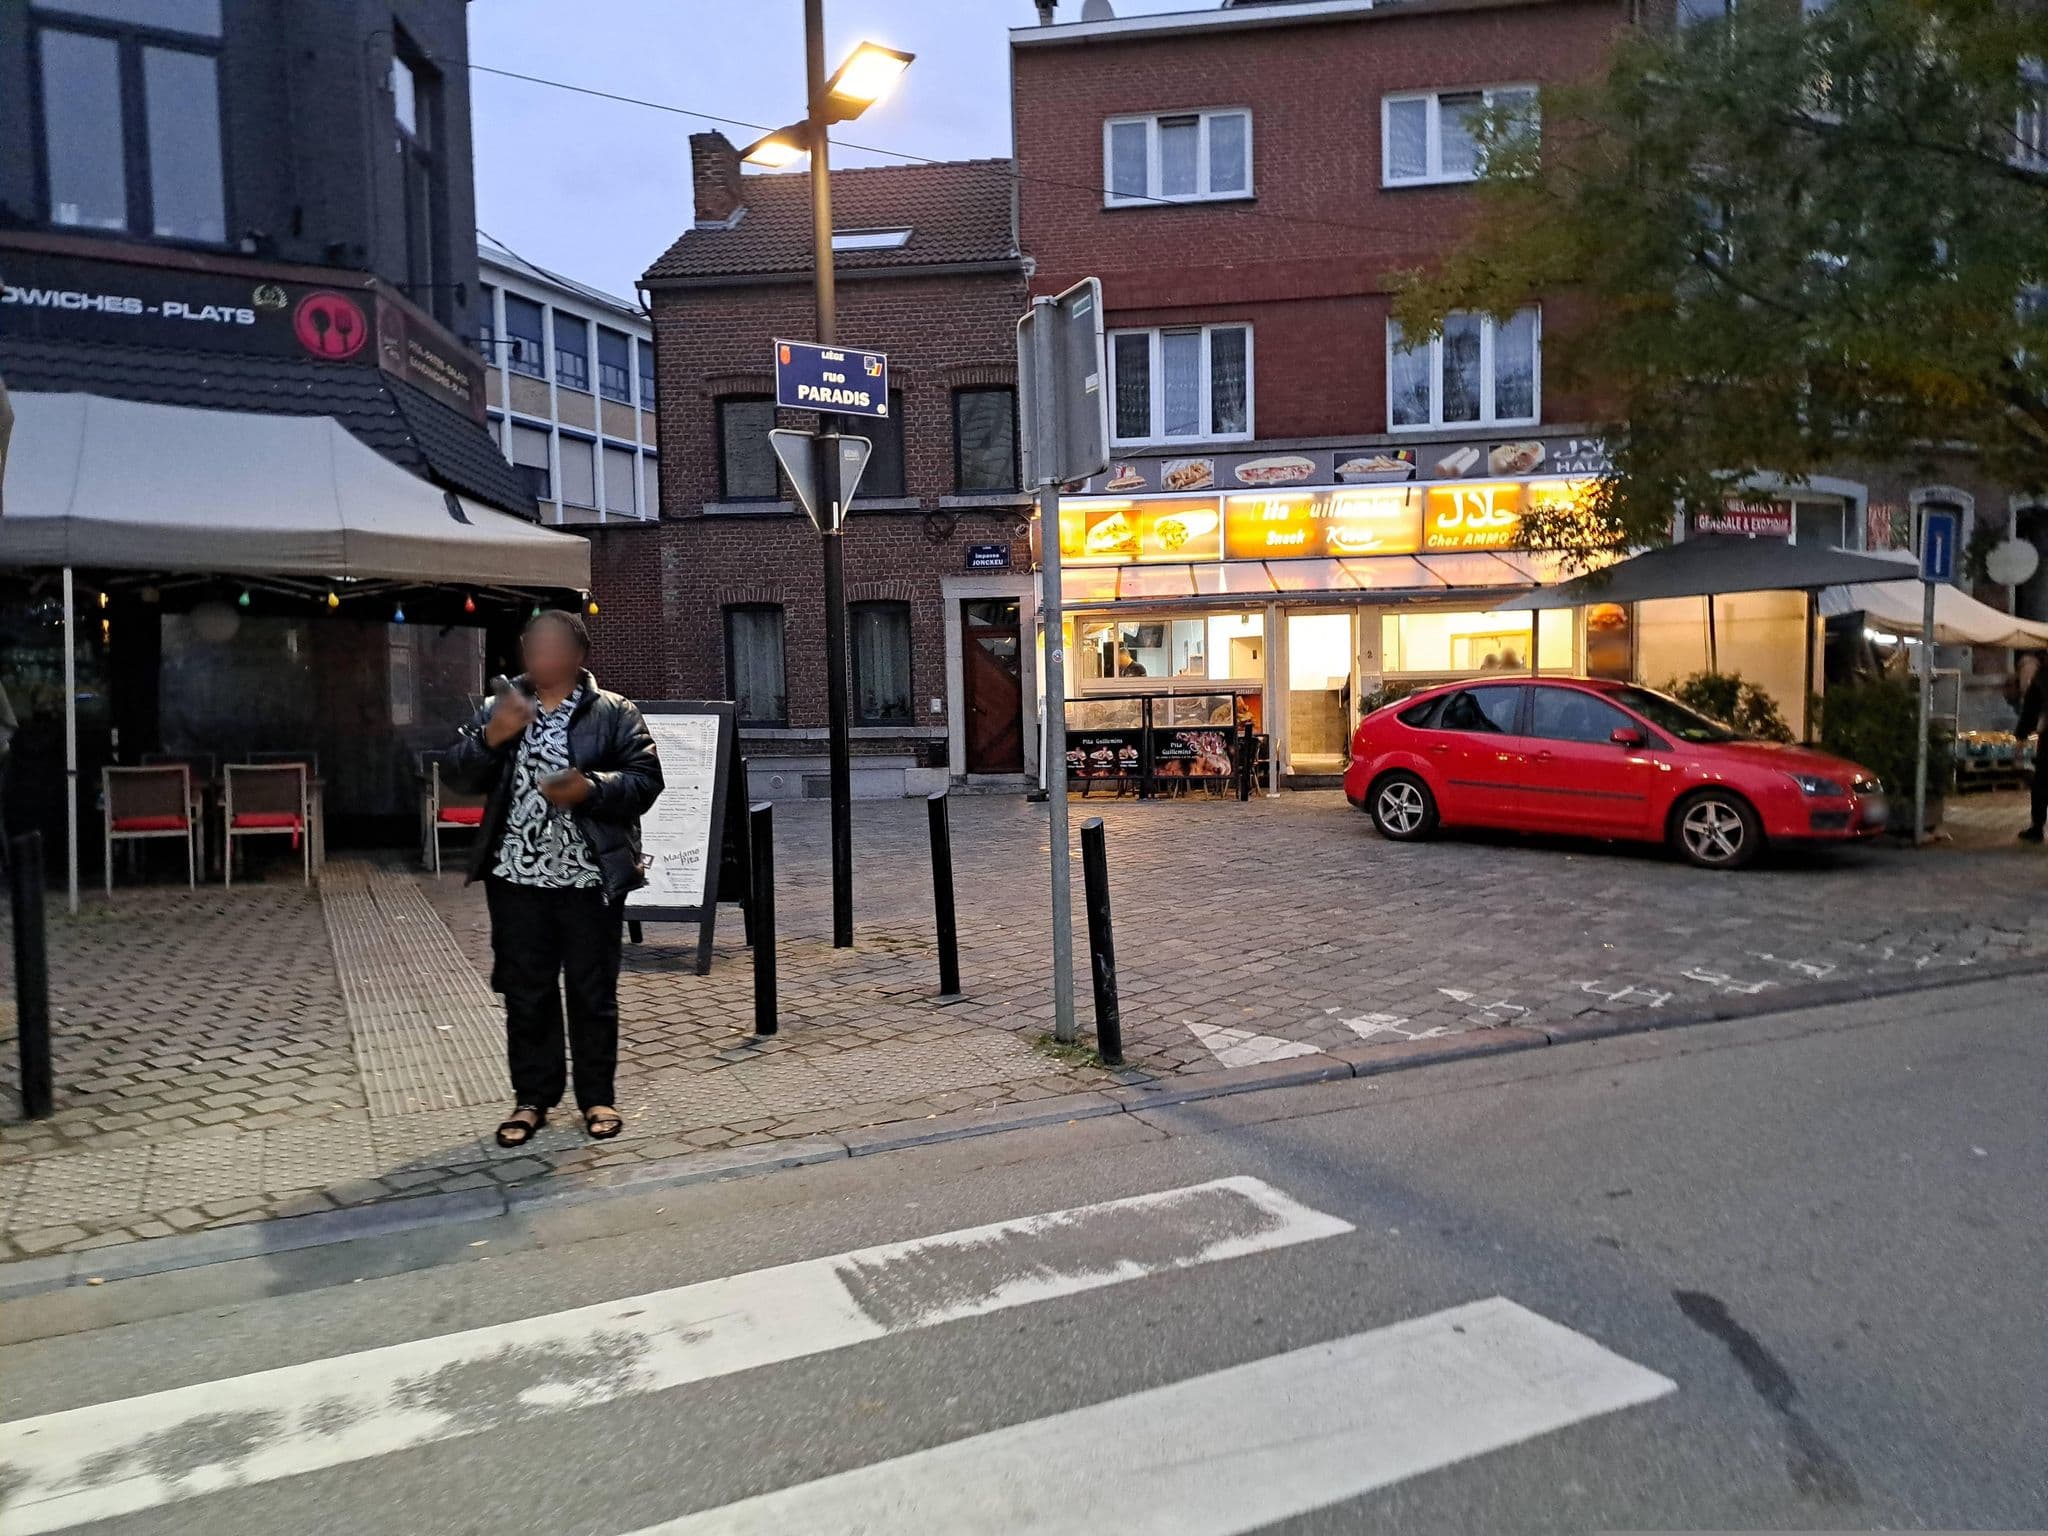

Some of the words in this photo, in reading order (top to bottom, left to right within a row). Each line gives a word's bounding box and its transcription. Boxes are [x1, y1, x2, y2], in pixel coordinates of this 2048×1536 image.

[162, 301, 256, 325] PLATS
[821, 351, 845, 361] LIÈGE
[822, 372, 846, 383] rue
[797, 384, 871, 407] PARADIS
[1556, 461, 1614, 473] HALA
[663, 848, 700, 863] Madame
